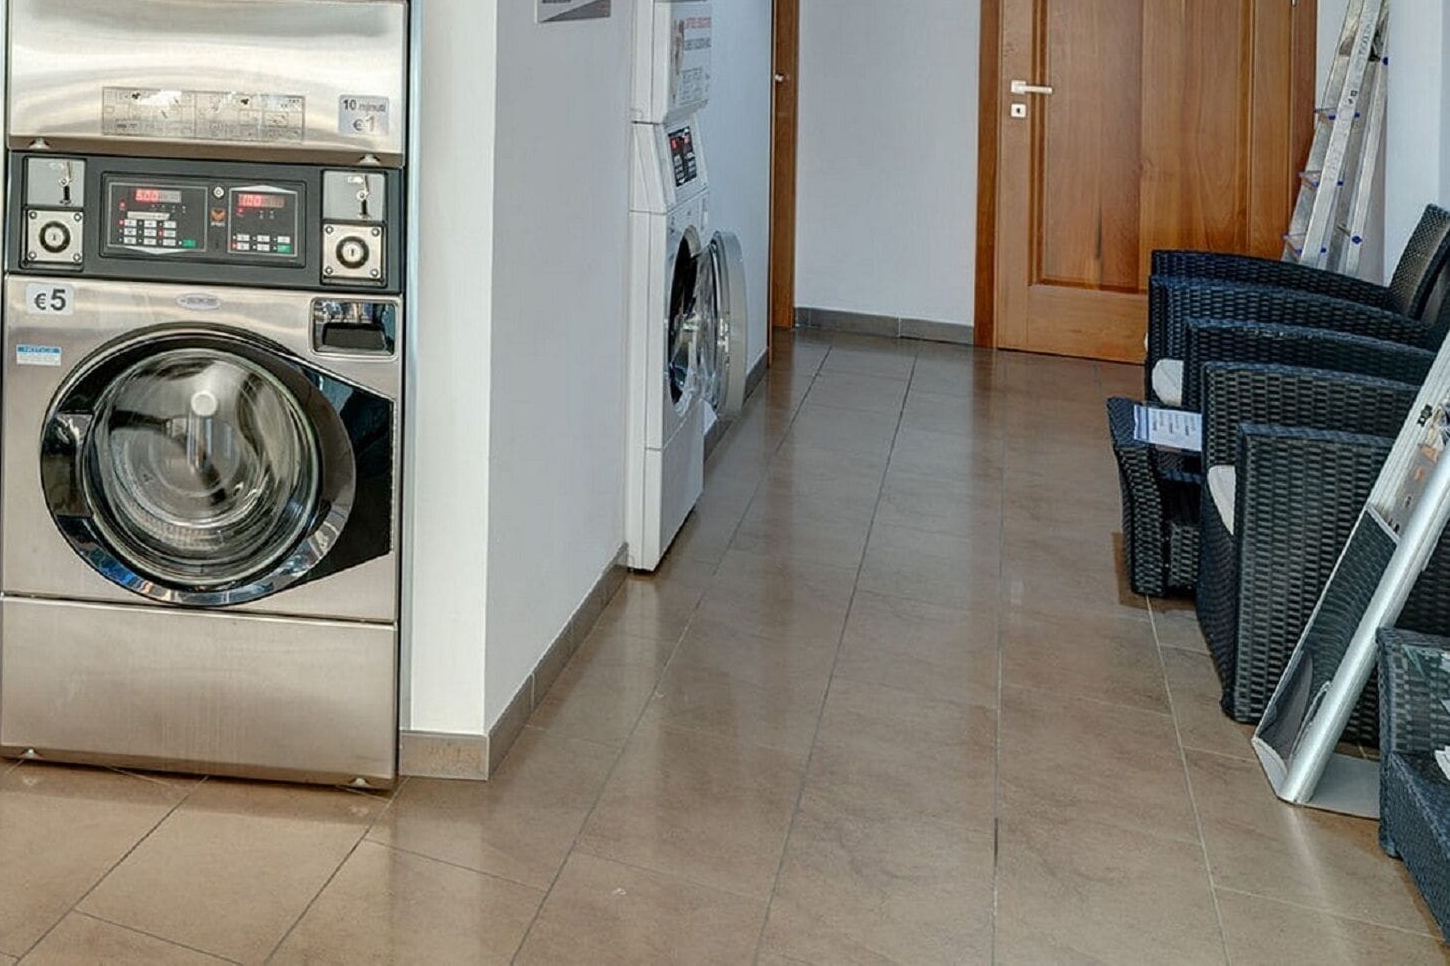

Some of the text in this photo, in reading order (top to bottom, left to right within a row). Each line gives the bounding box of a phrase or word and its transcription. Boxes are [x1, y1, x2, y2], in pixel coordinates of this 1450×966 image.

[343, 99, 357, 111] 10
[352, 115, 375, 132] €1
[34, 288, 67, 311] €5
